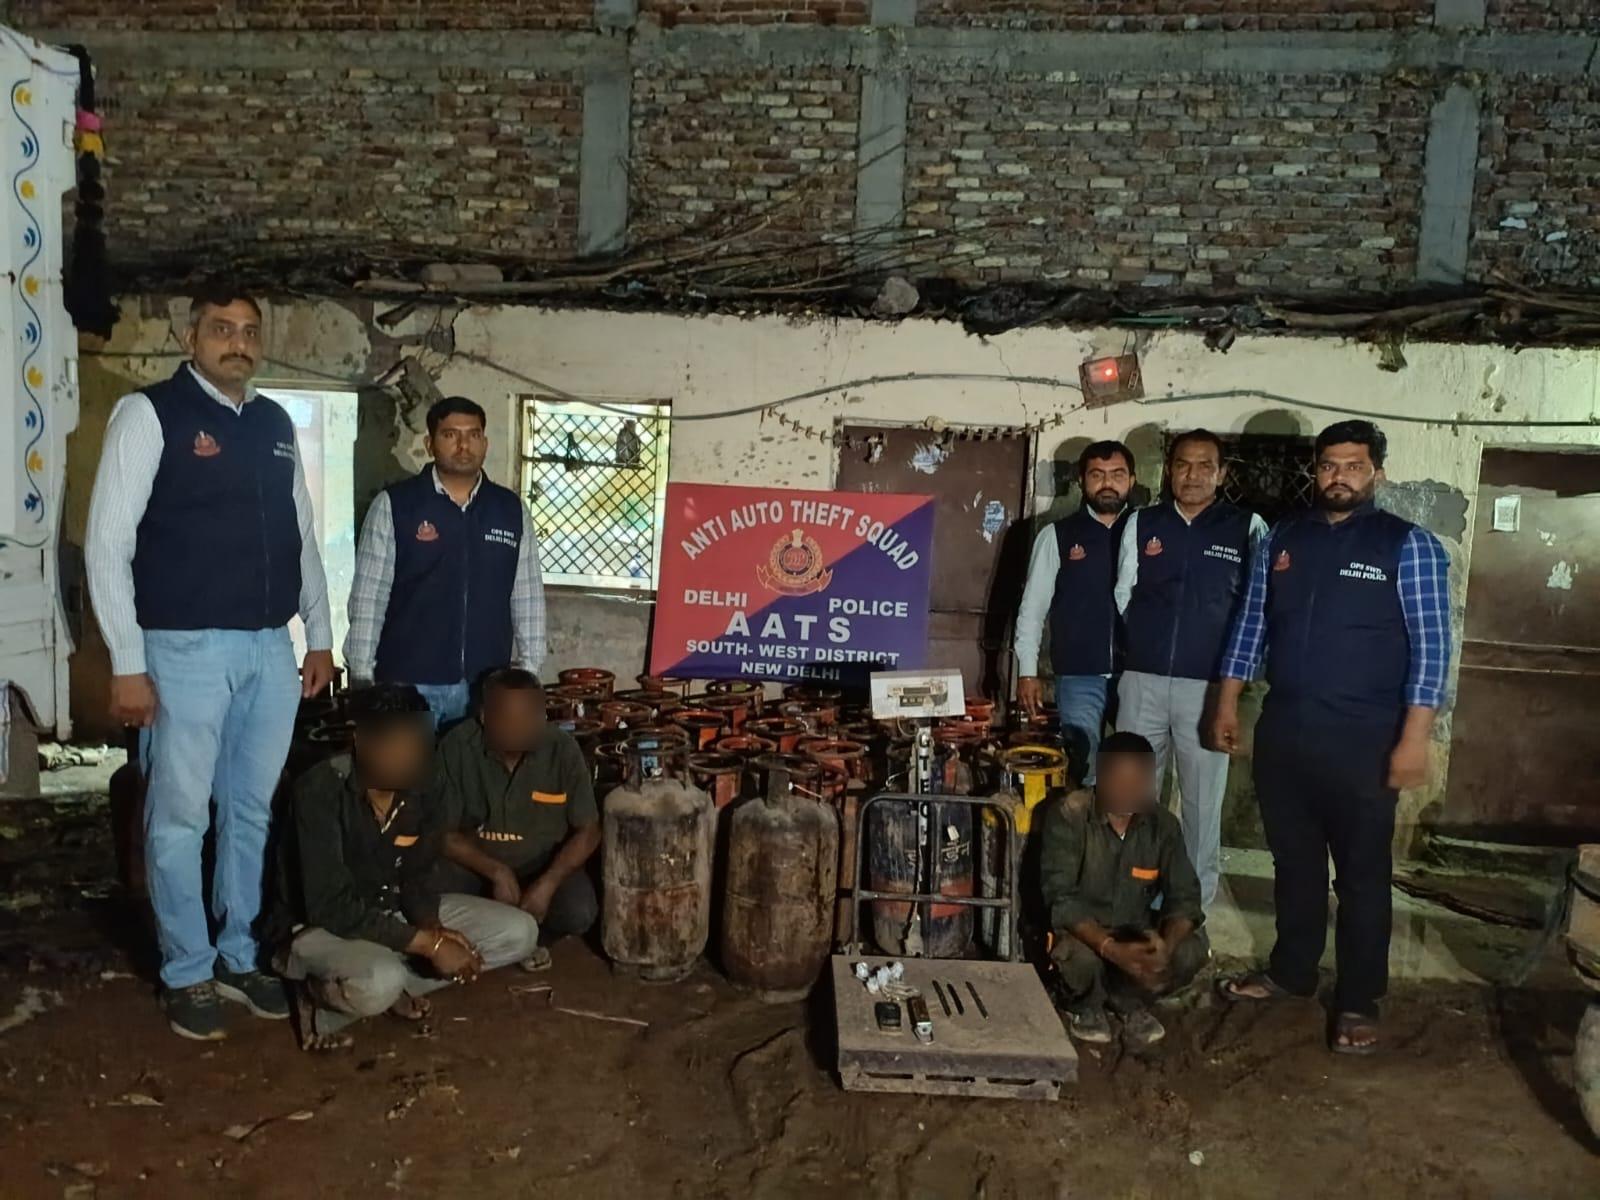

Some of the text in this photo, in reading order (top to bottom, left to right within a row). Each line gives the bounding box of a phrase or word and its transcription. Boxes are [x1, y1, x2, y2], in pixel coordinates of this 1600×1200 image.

[681, 500, 919, 570] ANTI AUTO THEFT SQUAD
[1203, 550, 1222, 558] DELHI
[1340, 569, 1361, 578] DELHI
[1350, 562, 1364, 570] OPS
[684, 589, 748, 607] DELHI
[828, 598, 908, 617] POLICE
[725, 610, 850, 643] A A T S
[686, 639, 899, 666] SOUTH- WEST DISTRICT
[740, 661, 840, 681] NEW DELHI
